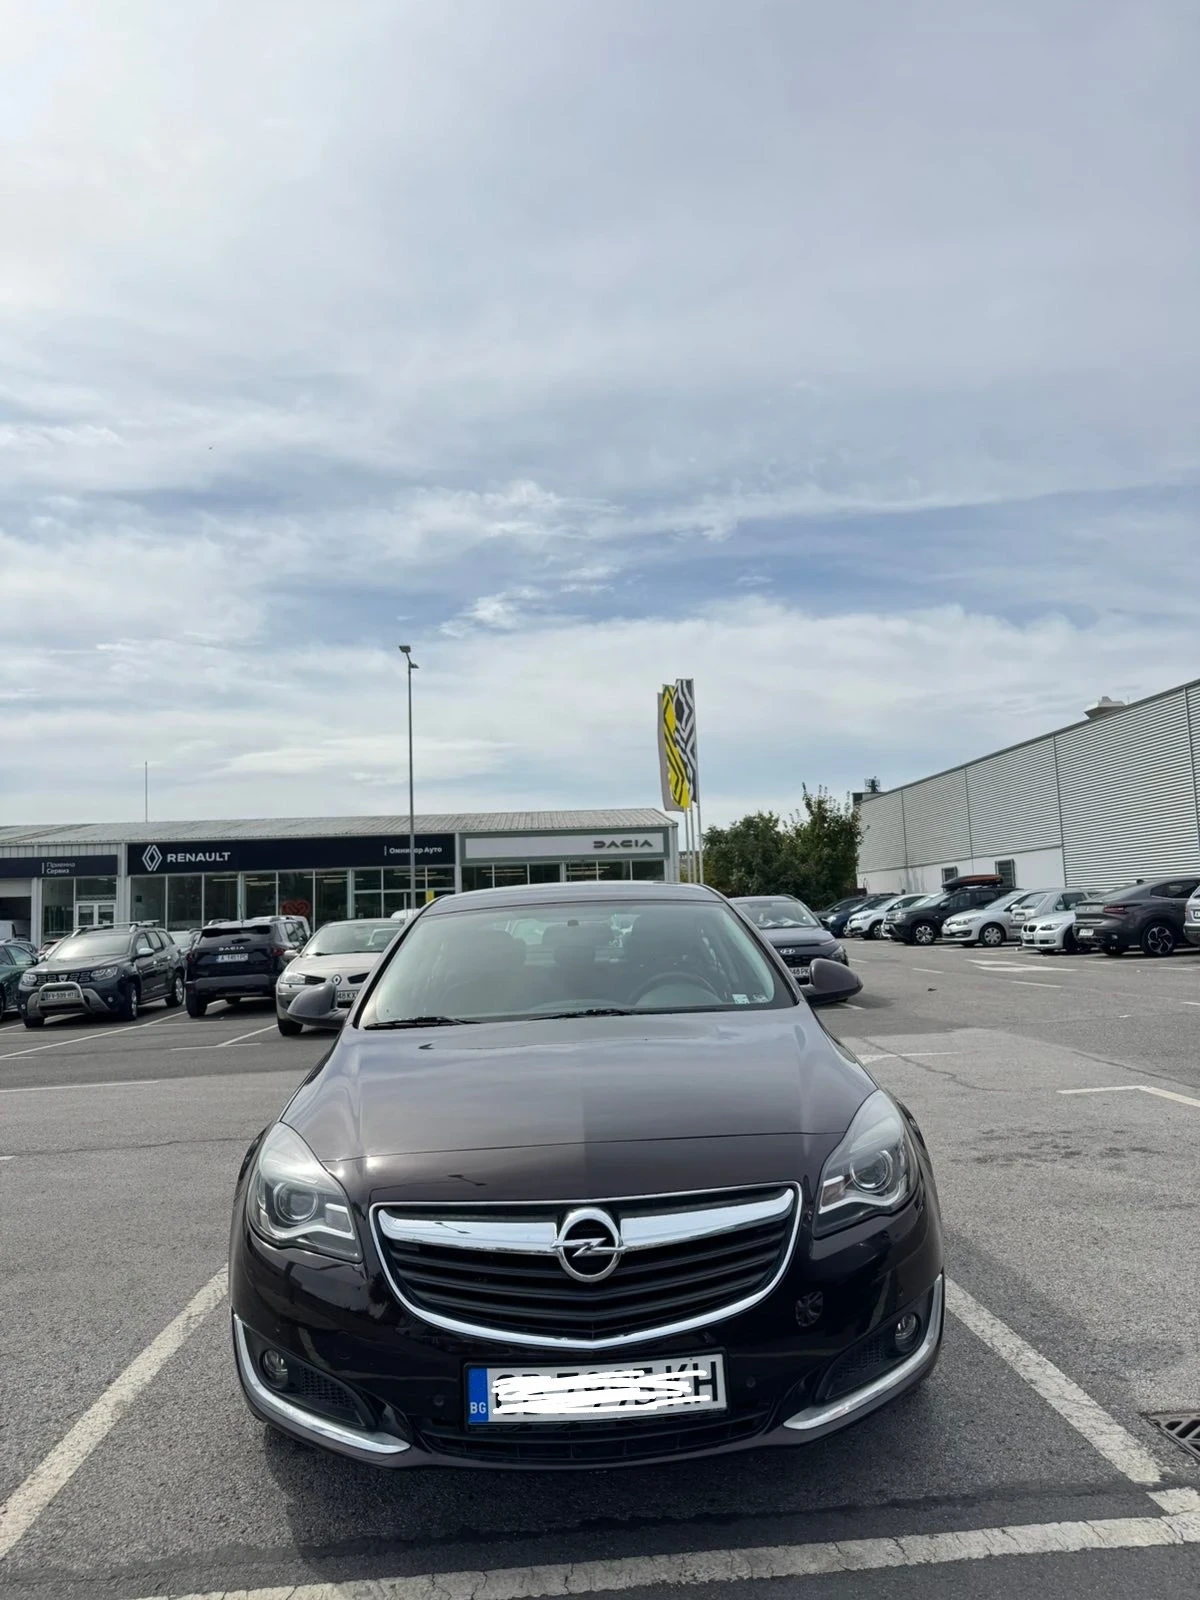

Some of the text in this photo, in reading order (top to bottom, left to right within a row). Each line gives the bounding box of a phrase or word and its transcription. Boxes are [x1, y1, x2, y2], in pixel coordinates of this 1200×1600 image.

[593, 839, 653, 849] DACIA
[424, 846, 442, 855] Ауто
[166, 852, 231, 863] RENAULT
[470, 1401, 487, 1414] BG
